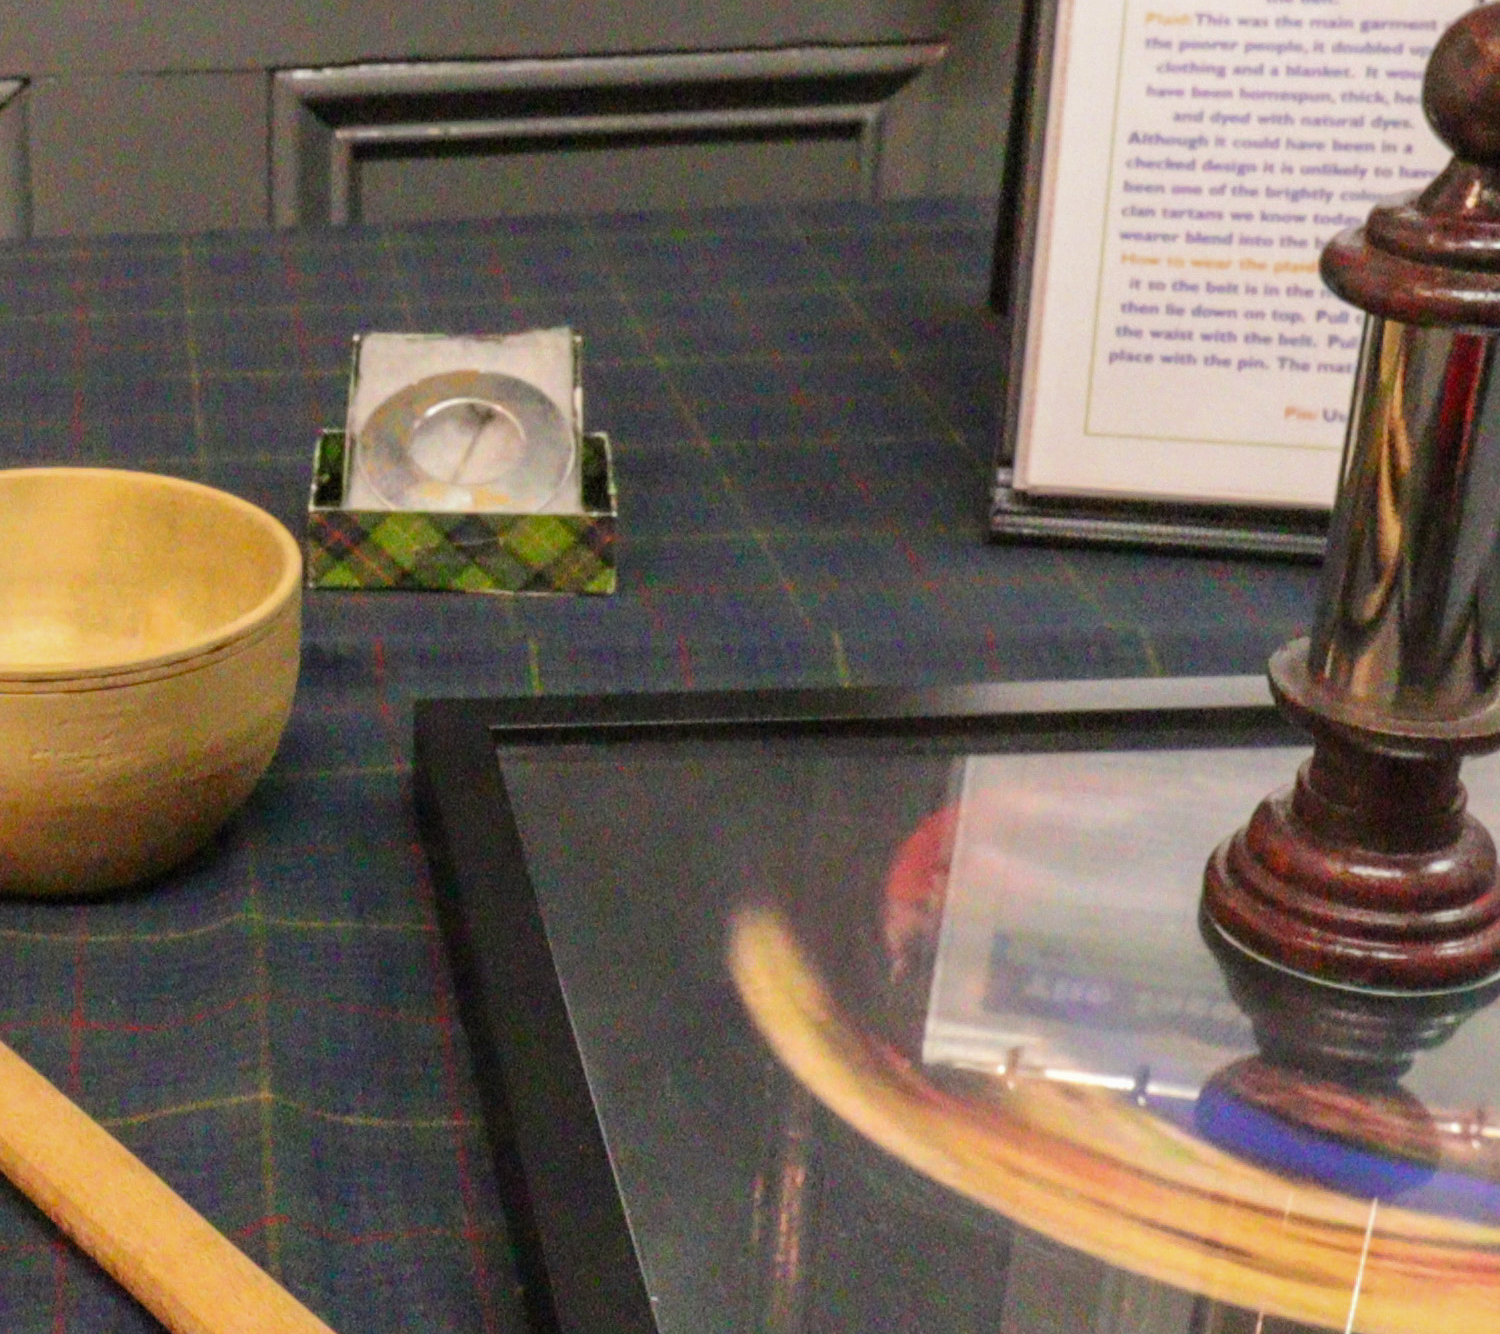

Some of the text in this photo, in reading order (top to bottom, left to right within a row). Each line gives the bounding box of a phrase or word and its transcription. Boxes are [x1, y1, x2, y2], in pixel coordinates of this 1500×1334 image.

[1129, 278, 1141, 290] it
[1148, 280, 1166, 291] so
[1172, 279, 1199, 293] the
[1206, 281, 1238, 294] belt
[1245, 283, 1258, 295] is
[1264, 284, 1279, 296] in
[1285, 285, 1314, 298] the
[1120, 302, 1159, 315] then
[1165, 303, 1184, 316] lie
[1191, 305, 1238, 319] down
[1244, 310, 1265, 320] on
[1271, 309, 1305, 324] top.
[1316, 310, 1349, 324] Pull
[1115, 325, 1143, 338] the
[1150, 326, 1193, 341] waist
[1200, 330, 1237, 343] with
[1243, 331, 1272, 346] the
[1278, 333, 1316, 348] belt.
[1108, 349, 1153, 365] place
[1160, 351, 1196, 365] with
[1203, 352, 1231, 367] the
[1238, 355, 1269, 371] pin.
[1277, 357, 1310, 372] The
